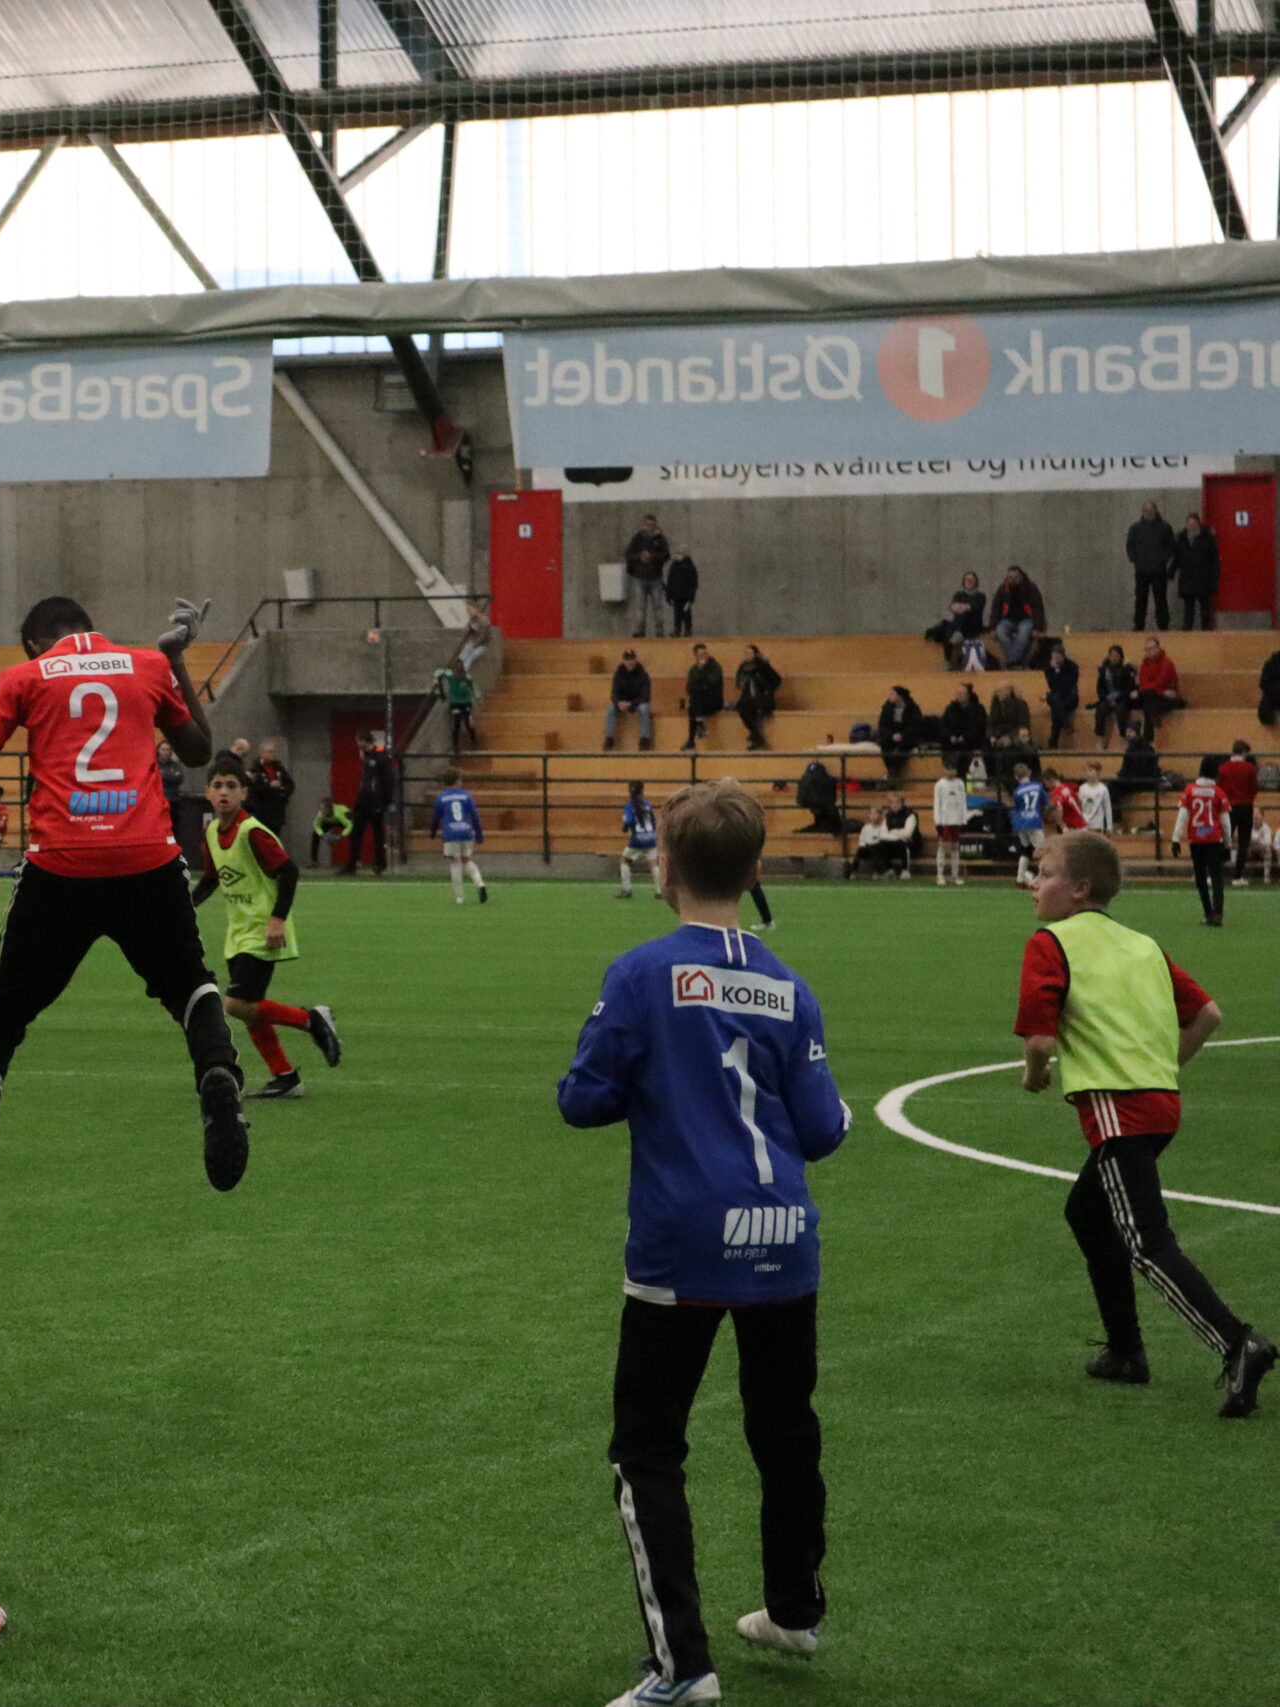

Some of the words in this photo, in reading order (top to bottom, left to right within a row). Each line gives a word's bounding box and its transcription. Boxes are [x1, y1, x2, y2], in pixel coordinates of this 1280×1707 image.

[78, 660, 130, 672] KOBBL
[70, 682, 124, 782] 2
[1022, 790, 1040, 810] 17
[1192, 798, 1214, 827] 21
[722, 986, 790, 1013] KOBBL
[722, 1037, 774, 1184] 1
